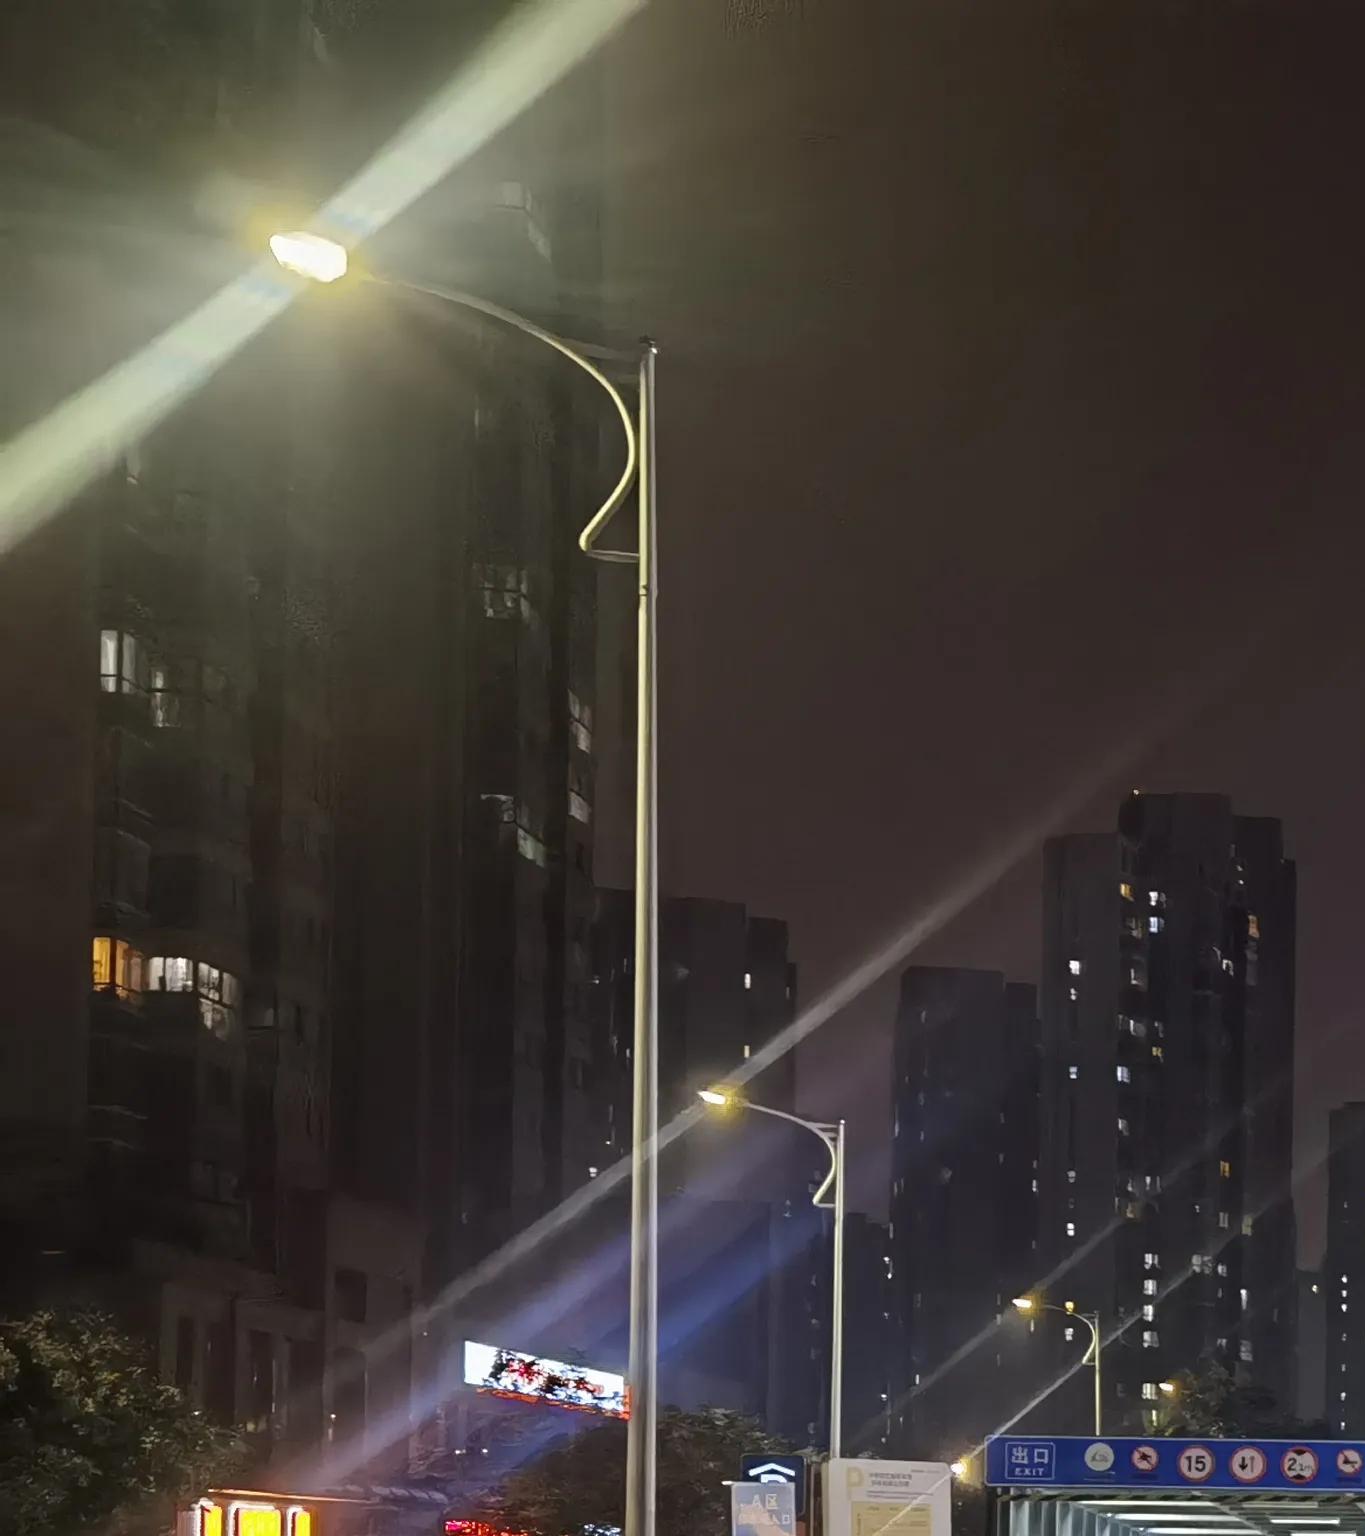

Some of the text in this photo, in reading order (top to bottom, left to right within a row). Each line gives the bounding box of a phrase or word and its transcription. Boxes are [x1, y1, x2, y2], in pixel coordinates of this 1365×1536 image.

[1011, 1446, 1049, 1465] 出口
[1185, 1455, 1207, 1473] 15
[1015, 1467, 1045, 1476] EXIT
